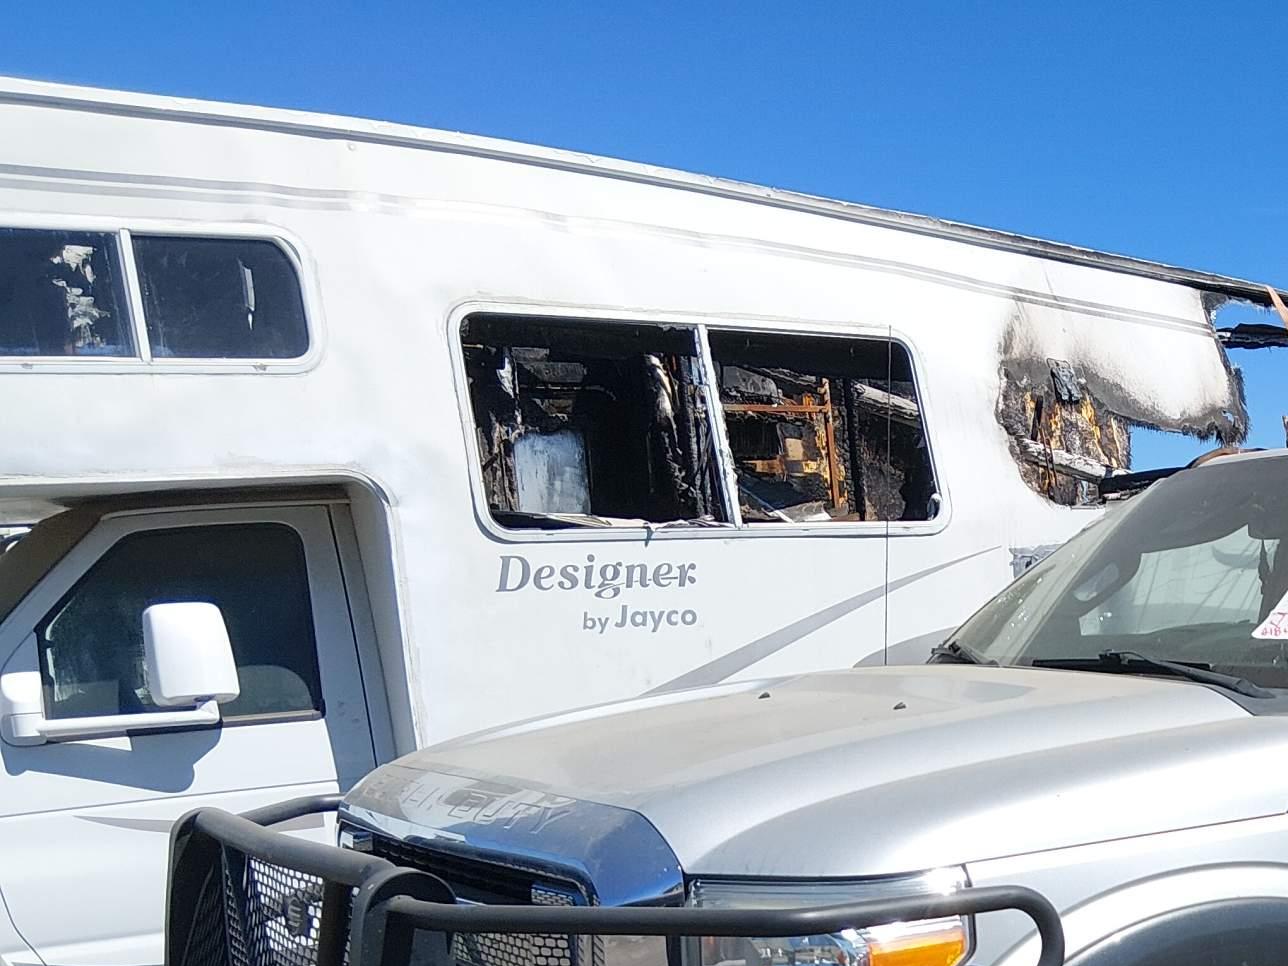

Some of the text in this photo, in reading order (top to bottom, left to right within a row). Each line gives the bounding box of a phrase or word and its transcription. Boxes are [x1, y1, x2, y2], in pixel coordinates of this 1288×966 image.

[495, 553, 697, 600] Designer
[582, 604, 698, 634] by Jayco
